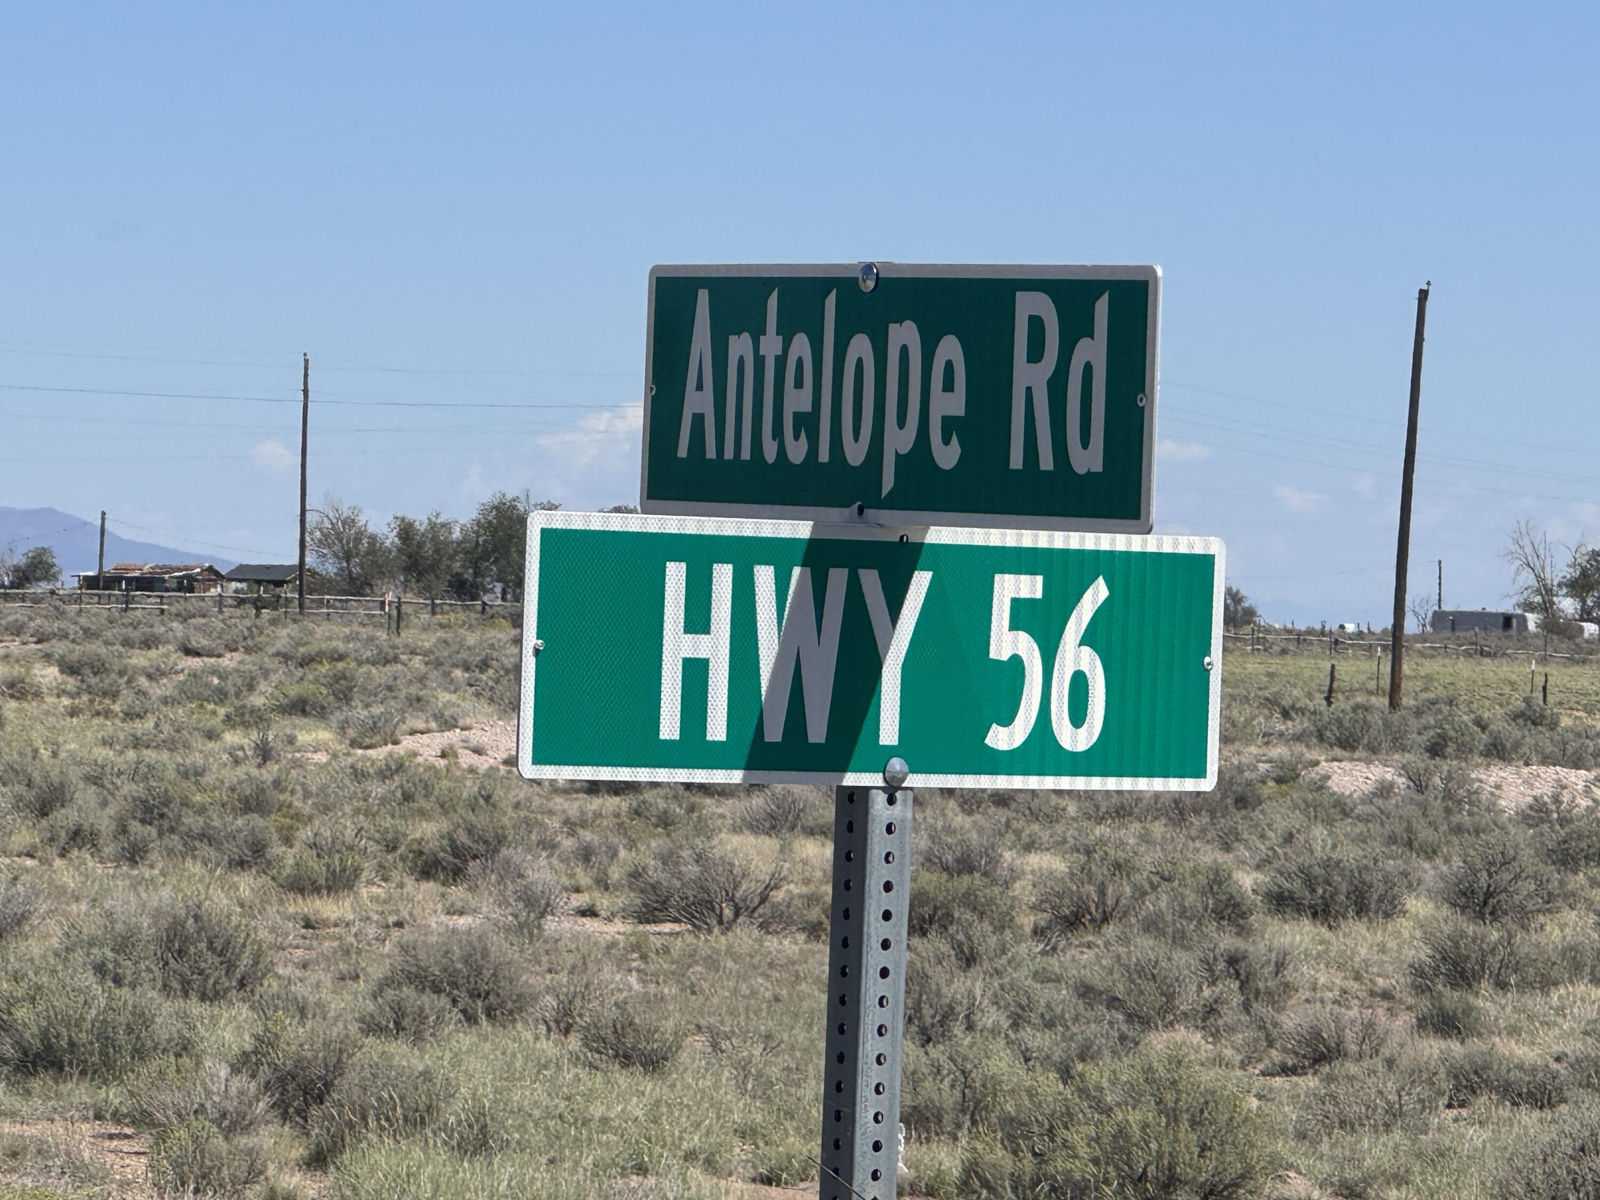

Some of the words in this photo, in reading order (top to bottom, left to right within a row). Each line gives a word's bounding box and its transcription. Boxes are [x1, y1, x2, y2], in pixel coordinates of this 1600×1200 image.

[676, 287, 966, 499] Antelope
[1009, 290, 1109, 475] Rd
[659, 561, 933, 746] HWY
[984, 574, 1110, 752] 56
